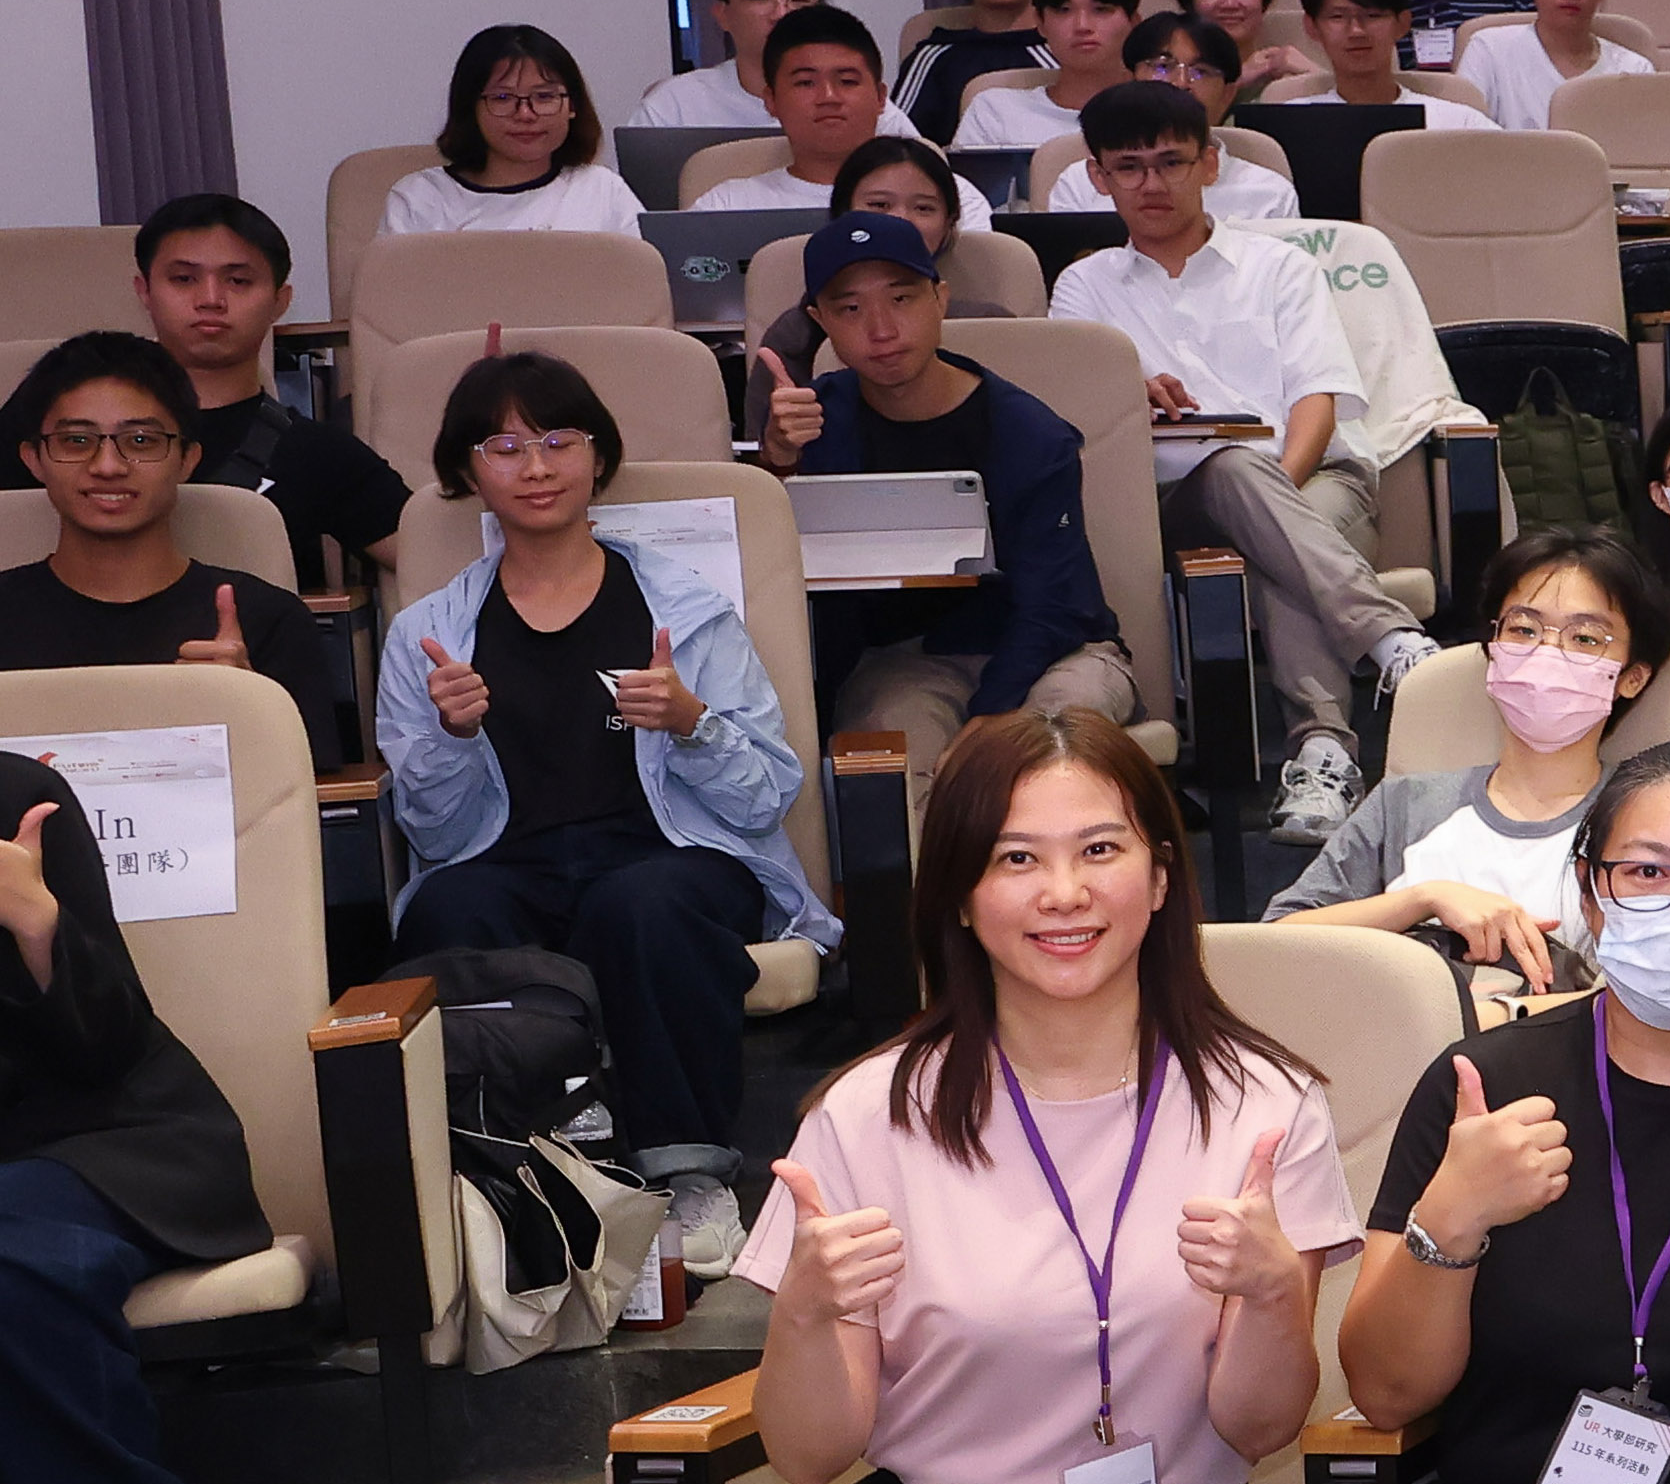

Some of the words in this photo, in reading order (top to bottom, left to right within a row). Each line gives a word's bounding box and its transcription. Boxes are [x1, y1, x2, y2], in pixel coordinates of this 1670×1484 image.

[102, 846, 190, 876] 團隊)
[1583, 1419, 1601, 1434] UR
[1571, 1440, 1593, 1456] 115
